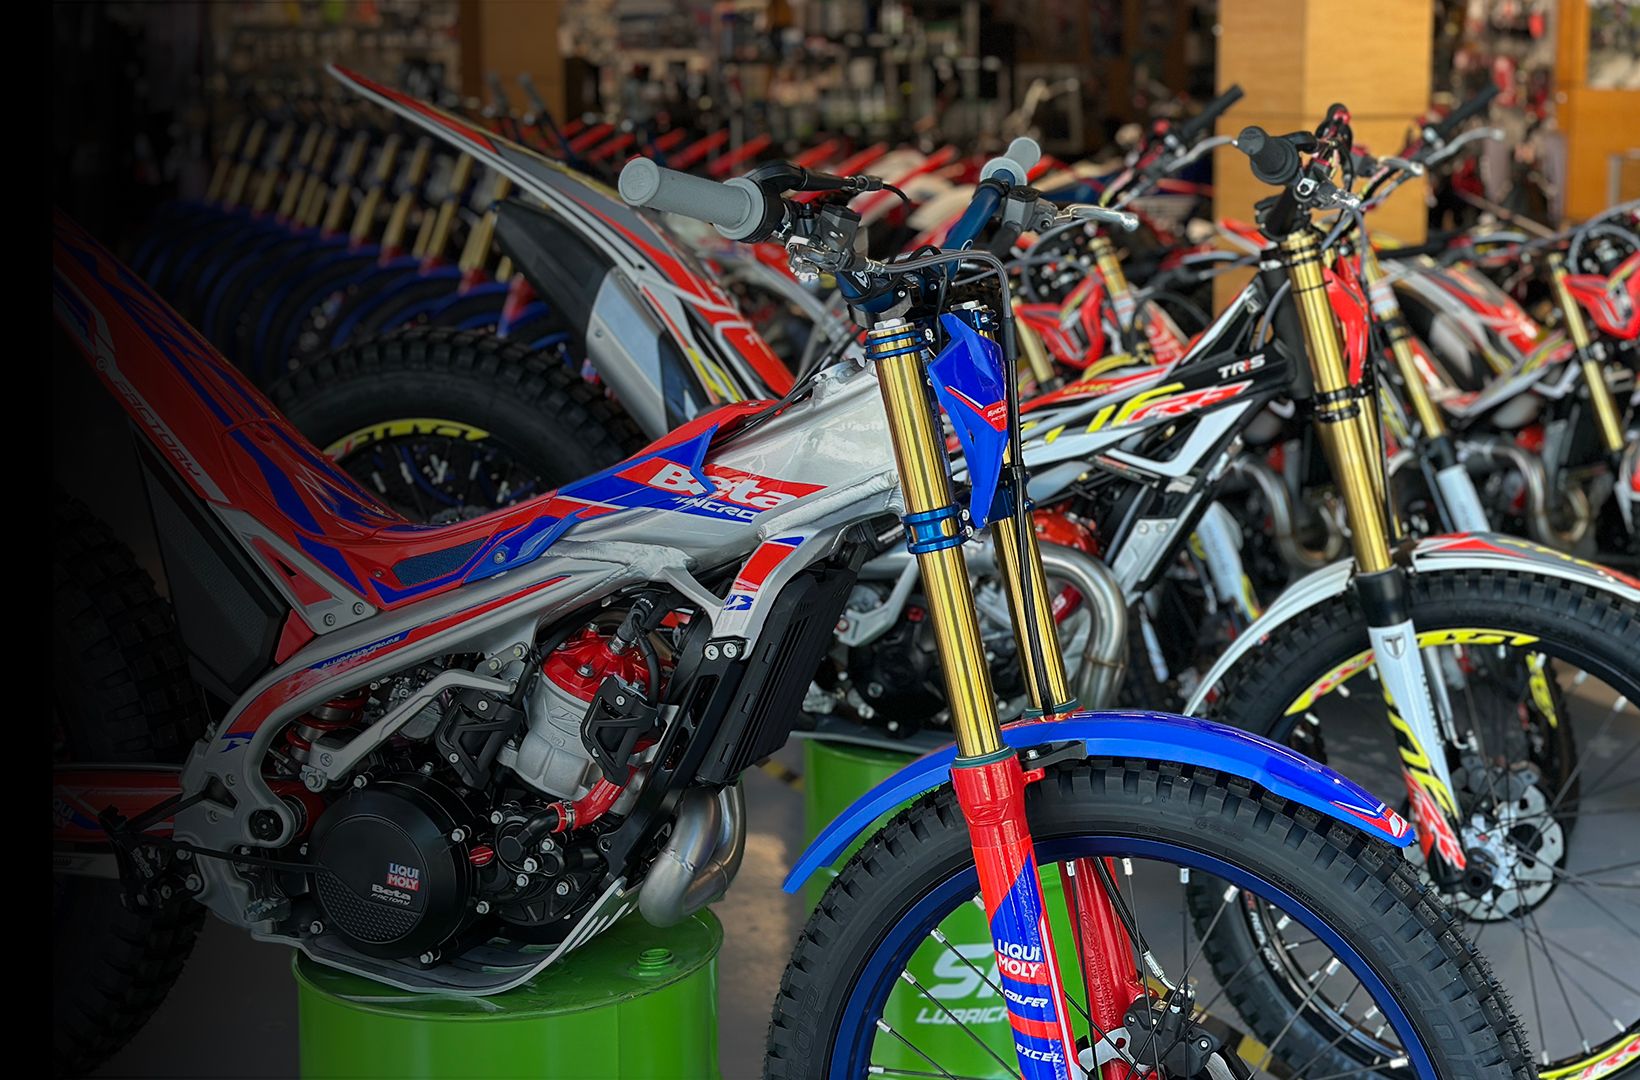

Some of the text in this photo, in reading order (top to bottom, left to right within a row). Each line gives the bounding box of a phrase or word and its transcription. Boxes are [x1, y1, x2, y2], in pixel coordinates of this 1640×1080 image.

[389, 863, 419, 878] LIQUI
[388, 873, 418, 890] MOLY
[370, 893, 410, 905] FACTORY
[371, 884, 411, 900] Beta
[997, 939, 1040, 961] LIQUI
[998, 955, 1040, 979] MOLY
[1004, 989, 1049, 1009] GALFER
[1016, 1043, 1064, 1063] EXCEL
